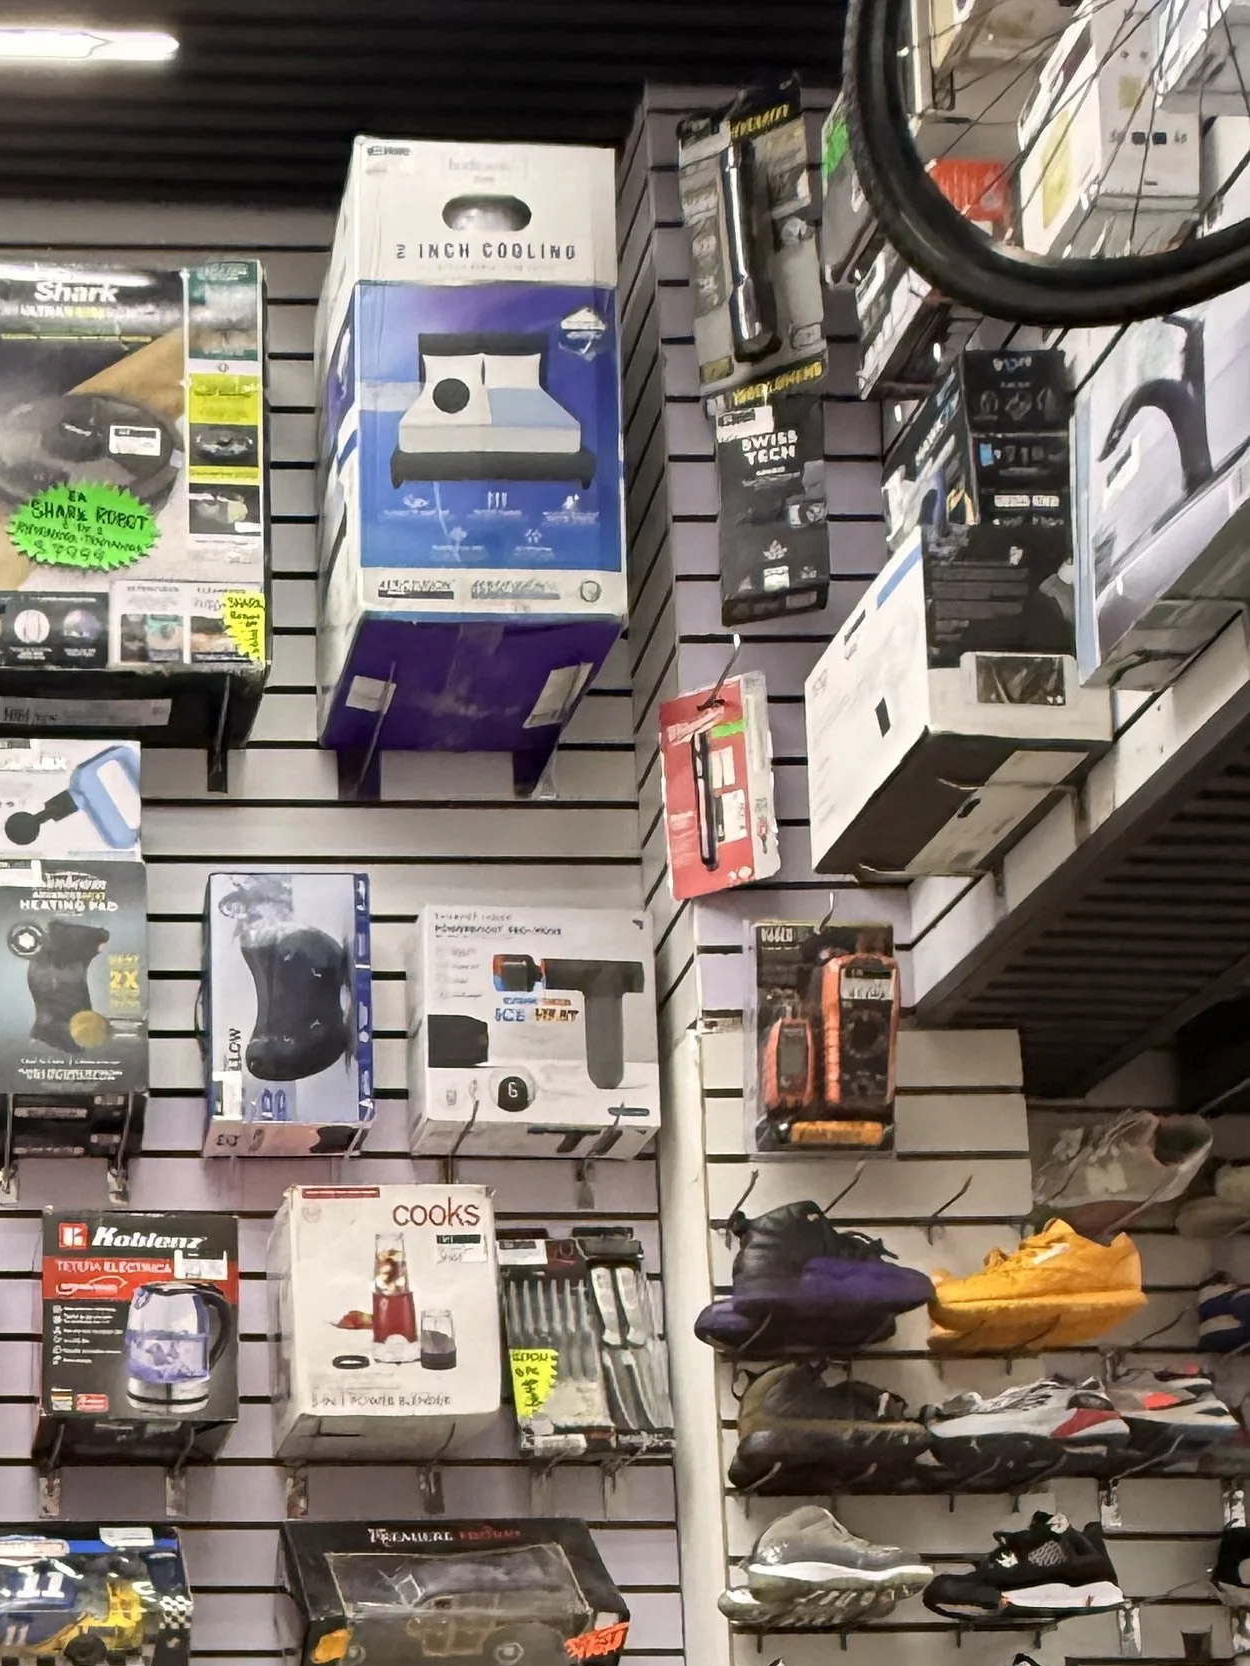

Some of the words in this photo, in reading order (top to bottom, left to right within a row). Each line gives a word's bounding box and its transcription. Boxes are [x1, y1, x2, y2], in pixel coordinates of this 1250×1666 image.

[419, 243, 470, 259] INCH
[34, 280, 120, 302] Shark
[744, 444, 797, 464] TECH
[393, 1197, 481, 1227] cooks
[91, 1226, 203, 1249] Koblenz
